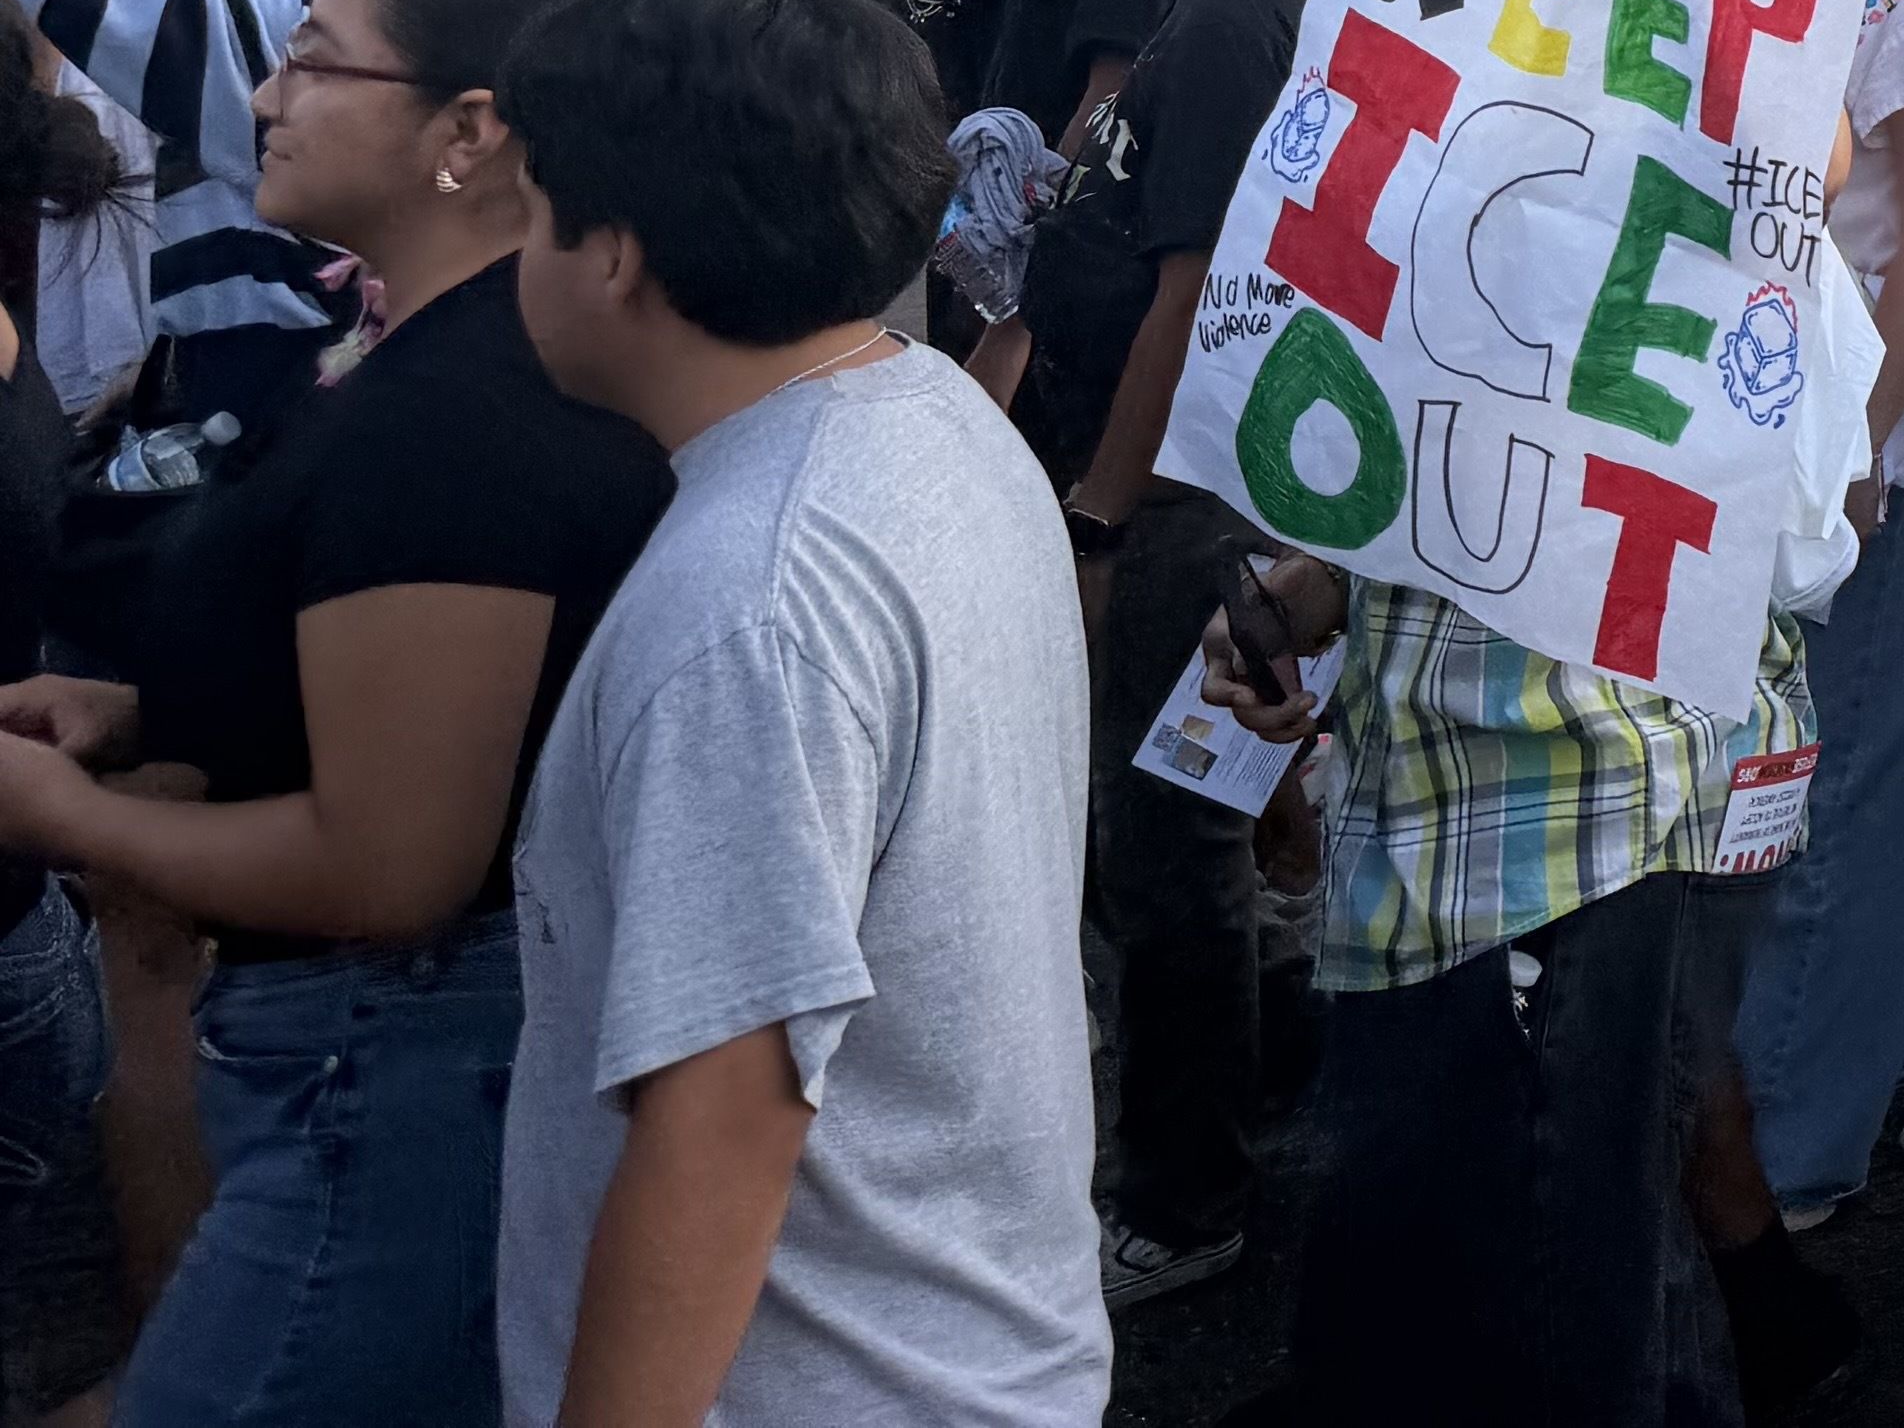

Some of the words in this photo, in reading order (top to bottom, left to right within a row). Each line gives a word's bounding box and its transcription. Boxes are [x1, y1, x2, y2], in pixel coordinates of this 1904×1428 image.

[1264, 8, 1736, 446] ICE
[1723, 146, 1822, 219] #ICE
[1750, 211, 1822, 288] OUT
[1235, 307, 1718, 682] OUT
